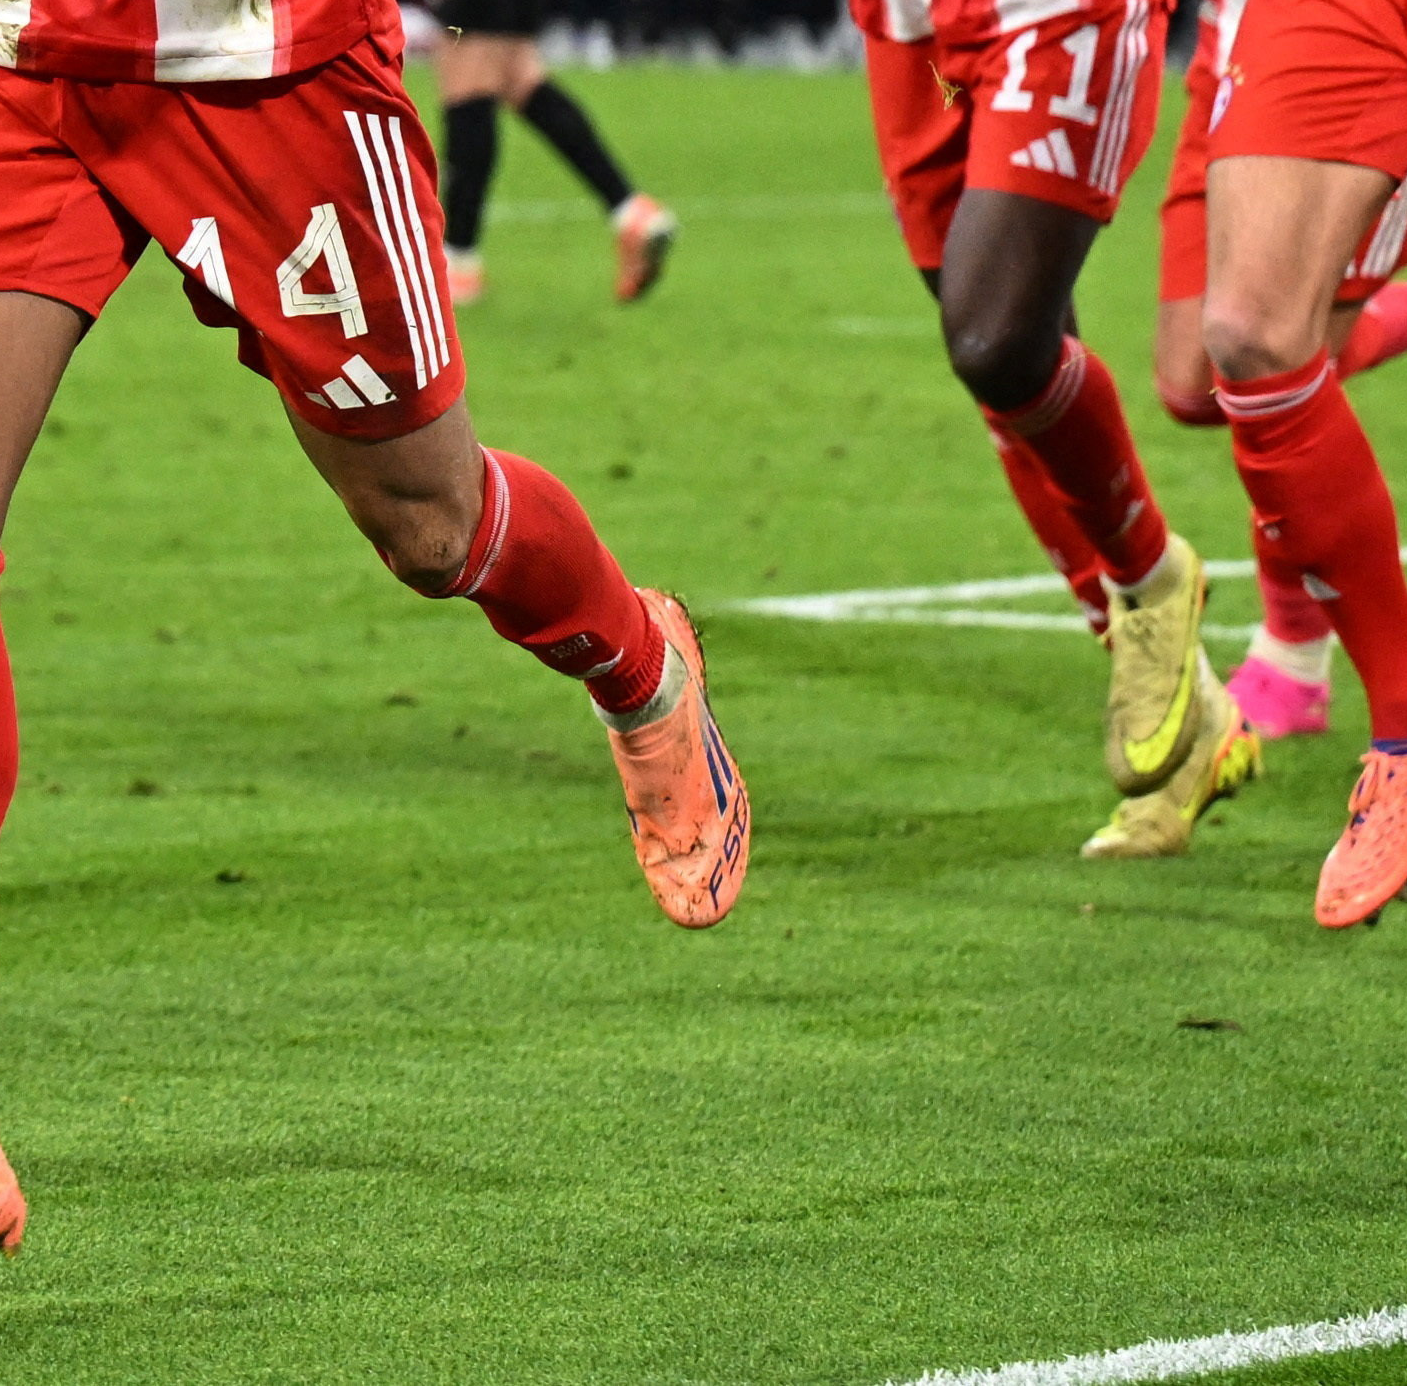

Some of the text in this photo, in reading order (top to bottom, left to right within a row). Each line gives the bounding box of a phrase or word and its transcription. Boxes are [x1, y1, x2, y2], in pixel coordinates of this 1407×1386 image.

[990, 22, 1101, 127] 11
[176, 202, 369, 340] 14
[708, 786, 748, 911] F50
